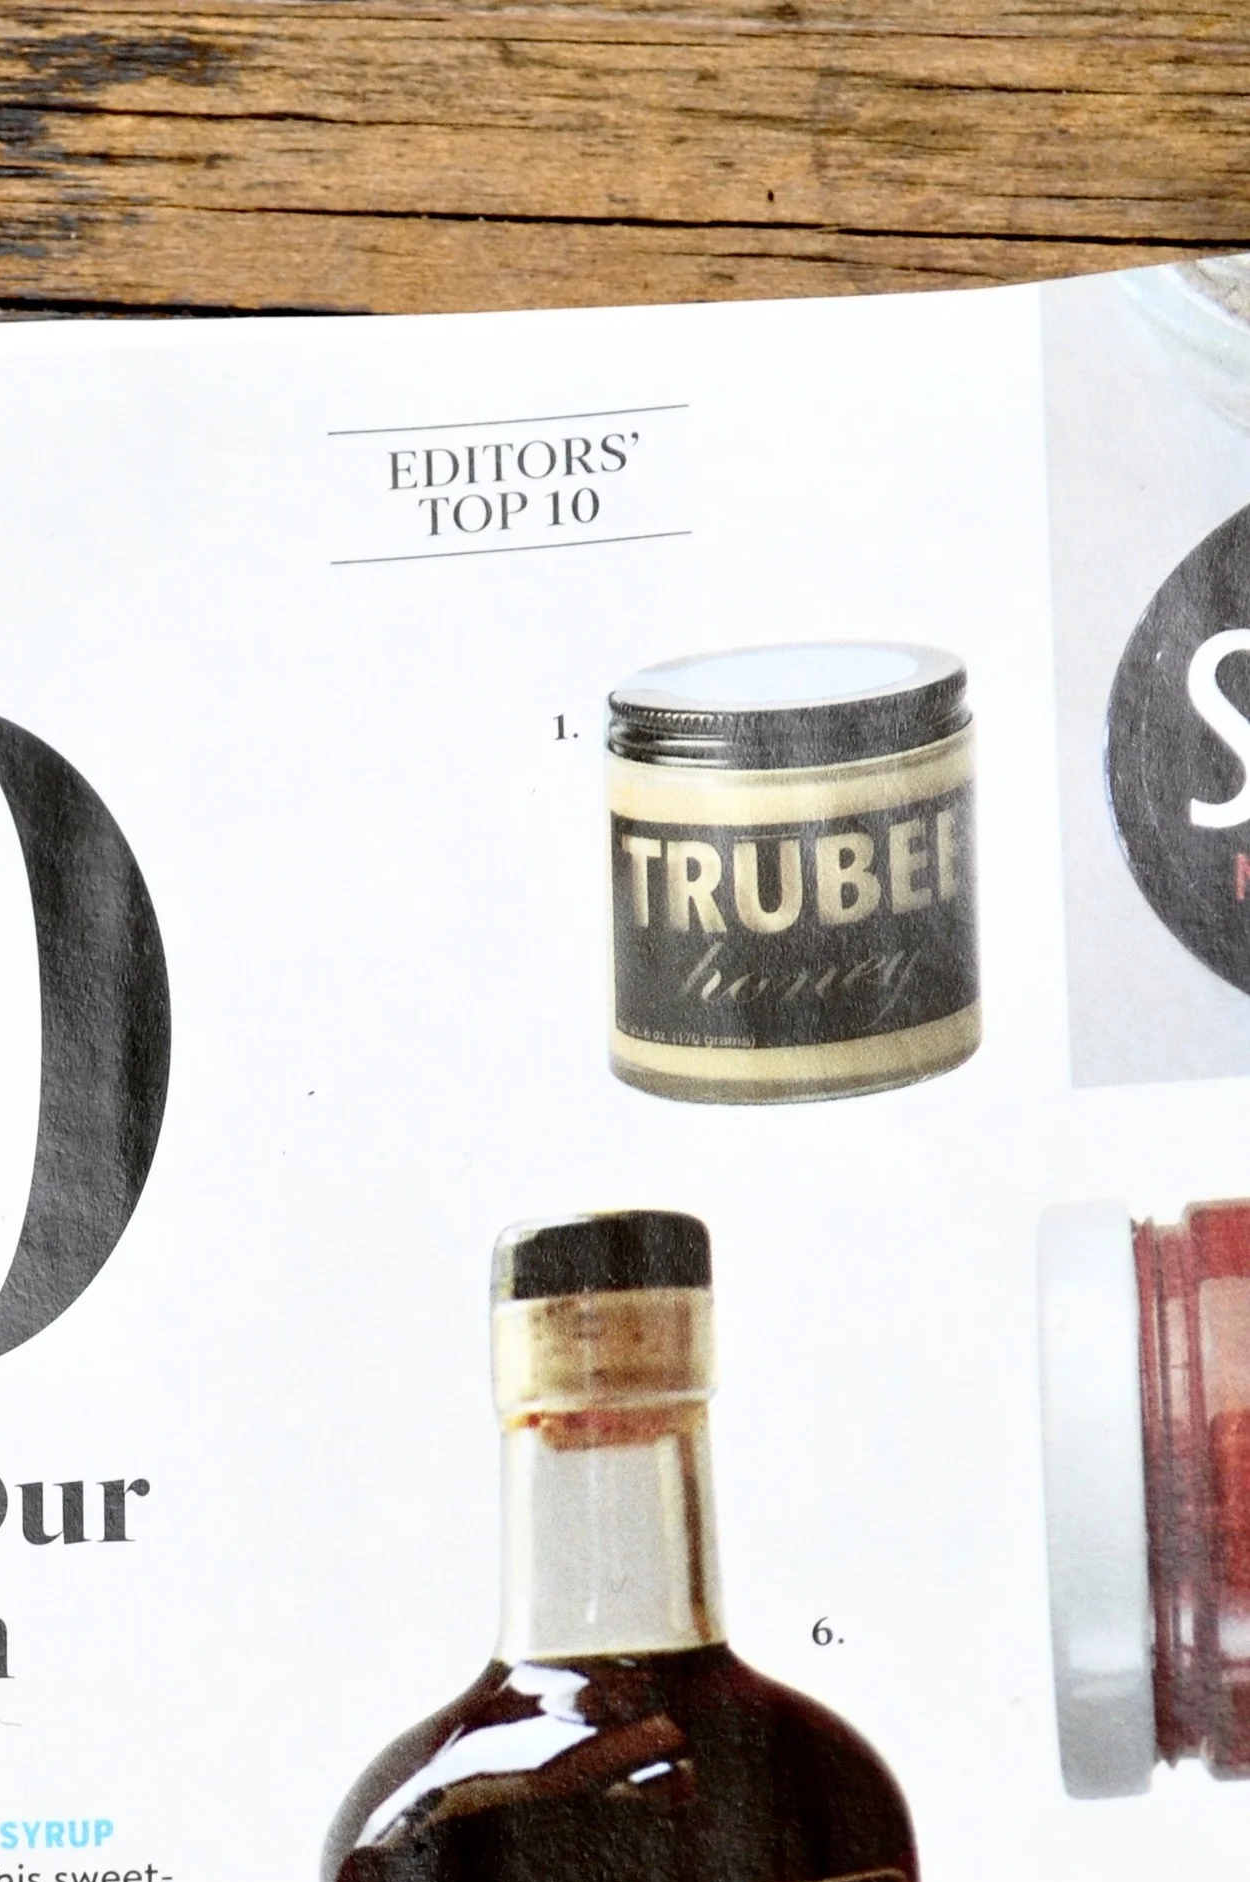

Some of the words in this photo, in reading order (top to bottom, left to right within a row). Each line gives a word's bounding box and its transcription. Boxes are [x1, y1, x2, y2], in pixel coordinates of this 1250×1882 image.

[418, 492, 528, 536] TOP
[546, 487, 600, 527] 10
[552, 714, 578, 741] 1.
[811, 1617, 845, 1646] 6.
[0, 1818, 114, 1849] SYRUP
